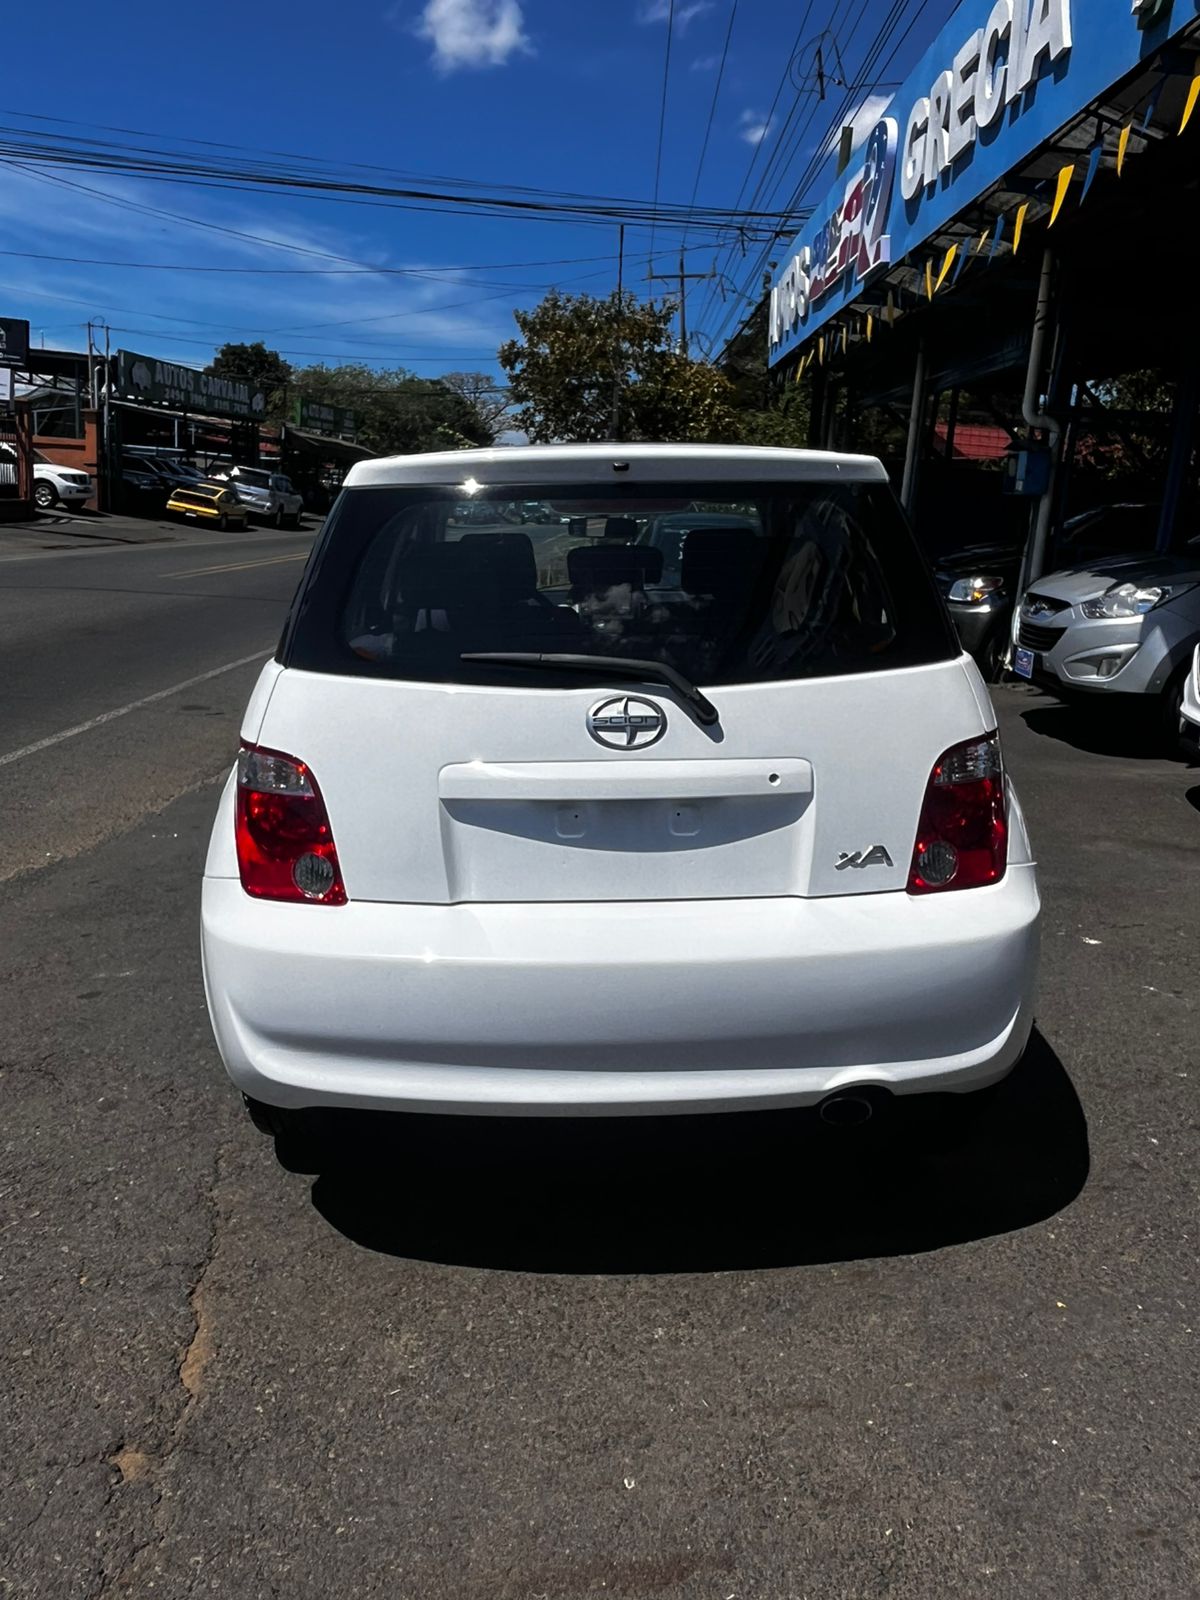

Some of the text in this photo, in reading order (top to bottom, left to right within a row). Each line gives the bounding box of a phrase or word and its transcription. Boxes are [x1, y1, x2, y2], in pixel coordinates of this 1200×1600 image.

[901, 0, 1071, 200] GRECIA
[155, 362, 194, 391] AUTOS
[592, 715, 661, 725] SCION
[835, 845, 894, 871] xA
